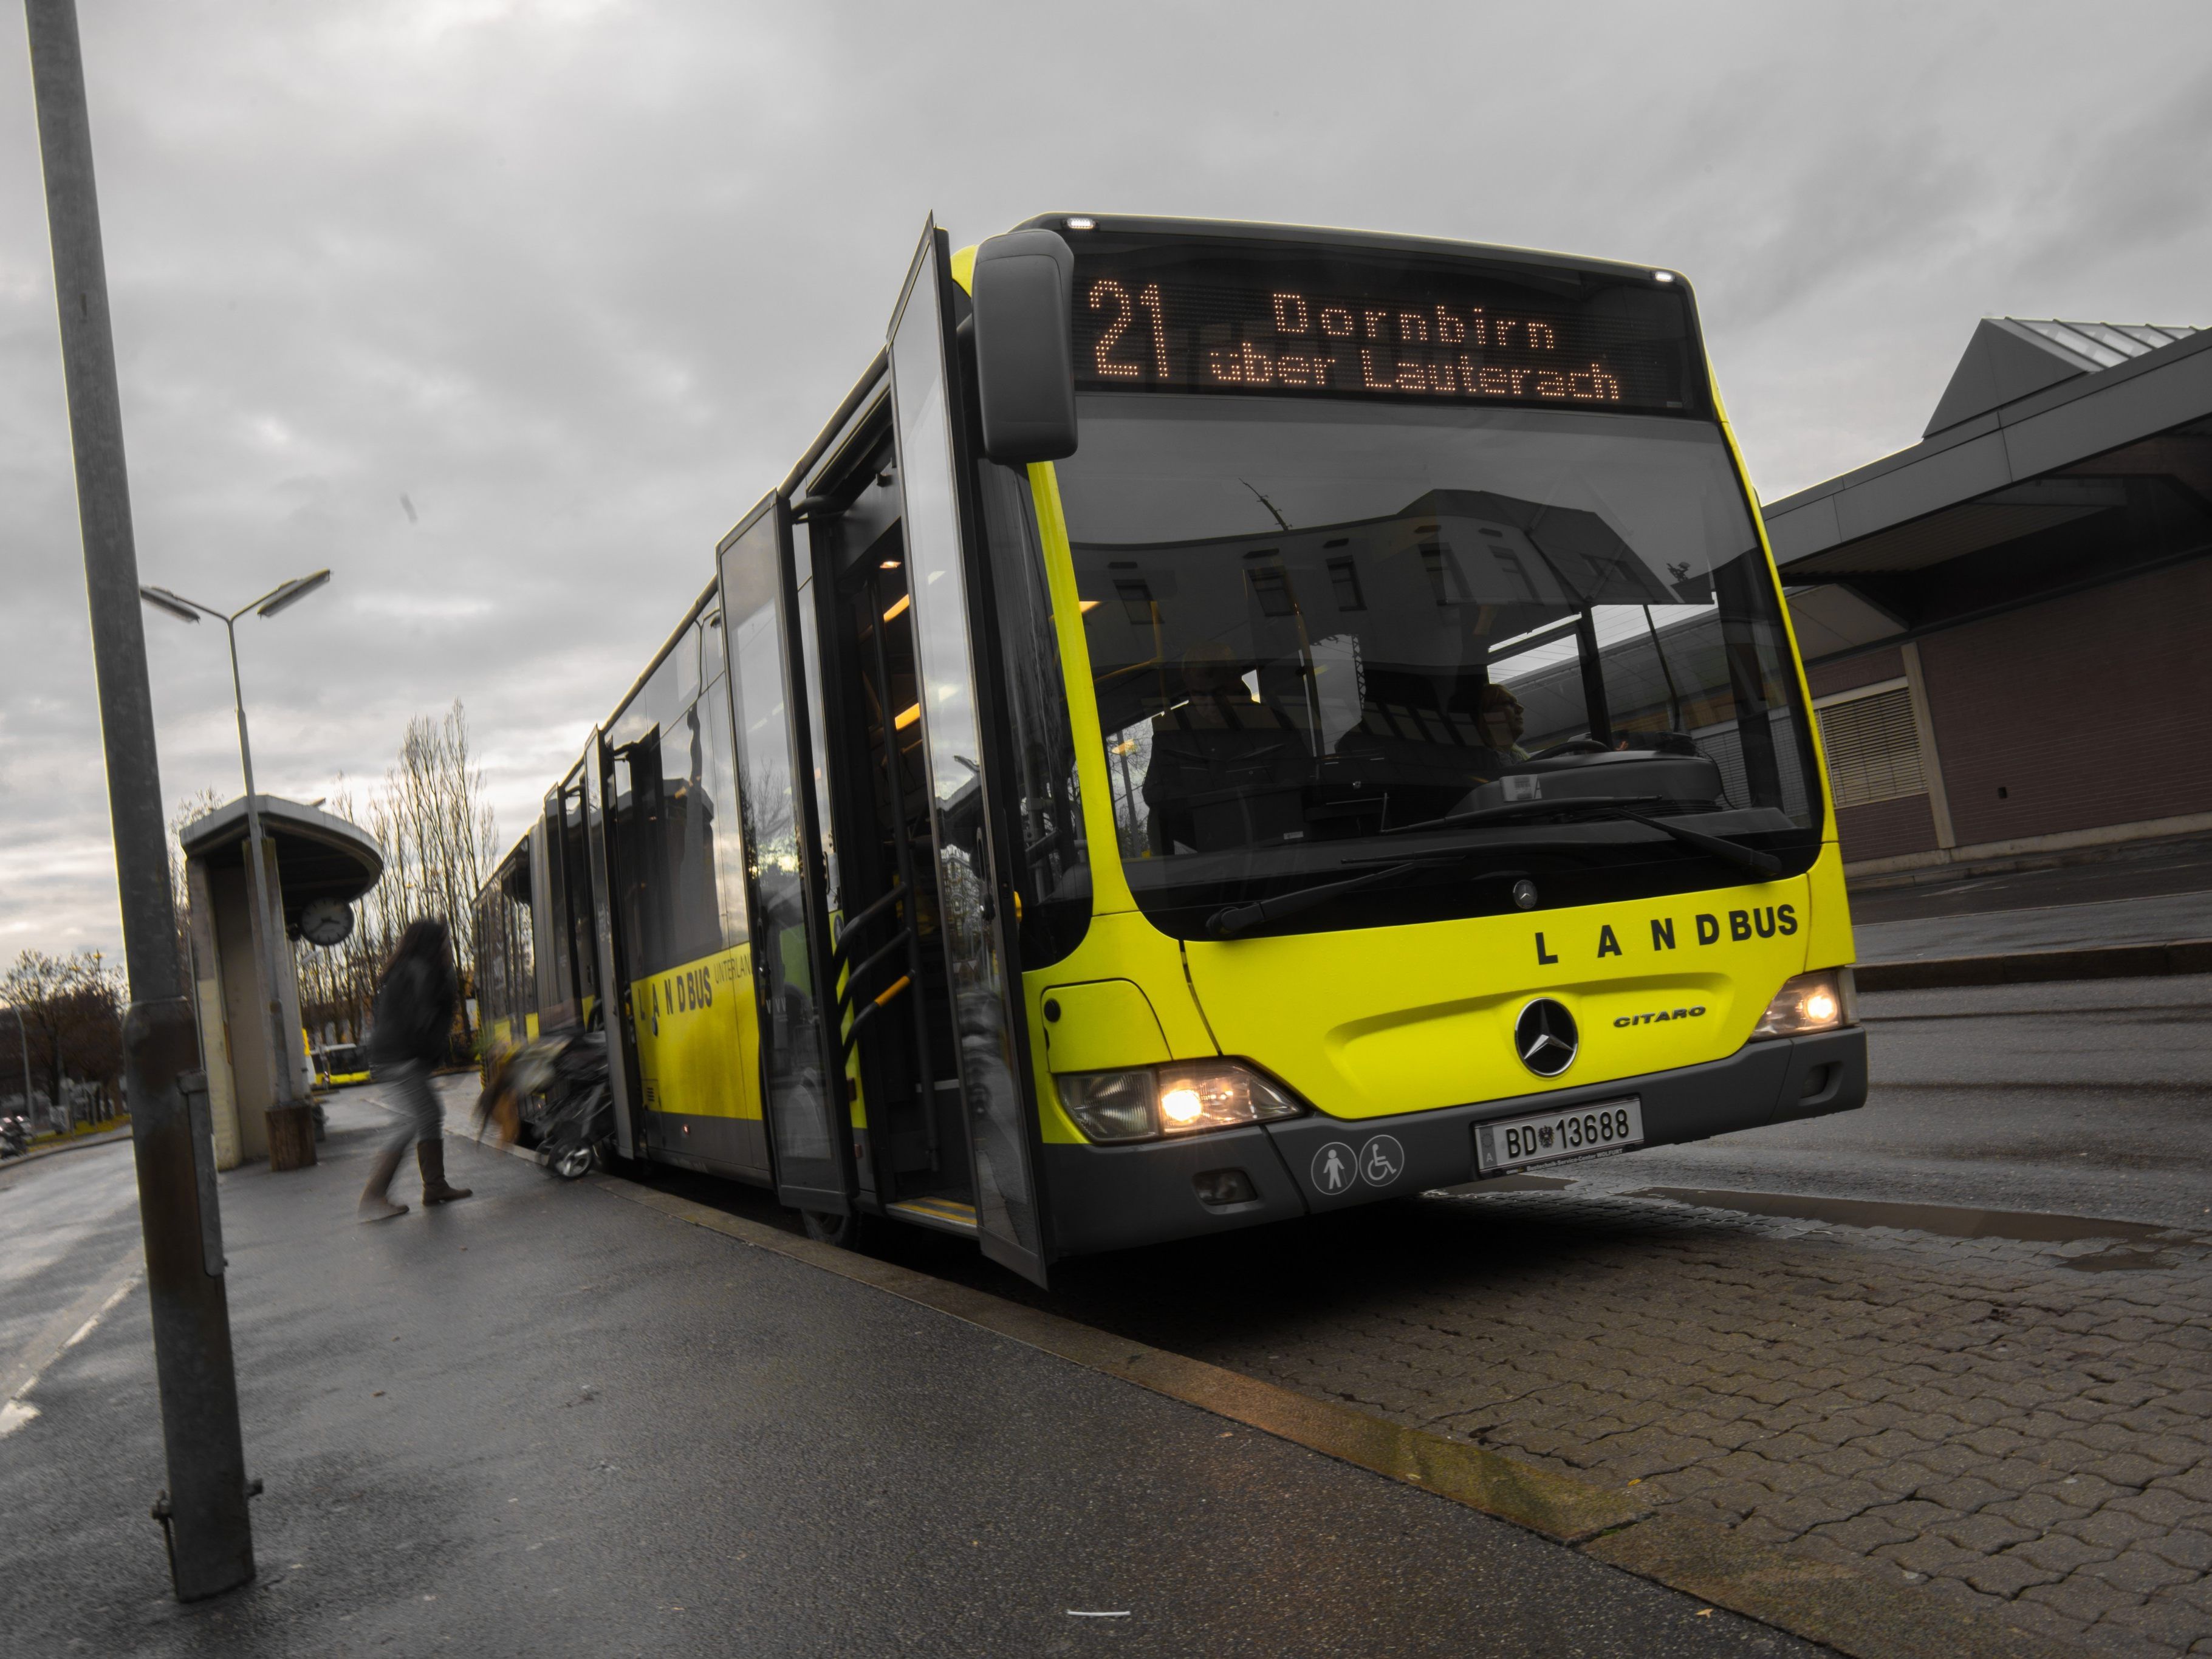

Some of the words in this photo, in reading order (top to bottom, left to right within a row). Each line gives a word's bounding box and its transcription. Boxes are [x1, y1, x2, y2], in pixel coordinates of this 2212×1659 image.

[1090, 280, 1169, 377] 21
[1273, 293, 1554, 350] Dornbirn
[1211, 342, 1335, 385] über
[1361, 349, 1620, 400] Lauterach
[1613, 1005, 1707, 1028] CITARO
[1485, 1153, 1494, 1162] A
[1505, 1124, 1538, 1159] BD
[1555, 1107, 1629, 1149] 13688
[1596, 1148, 1623, 1158] WOLFURT
